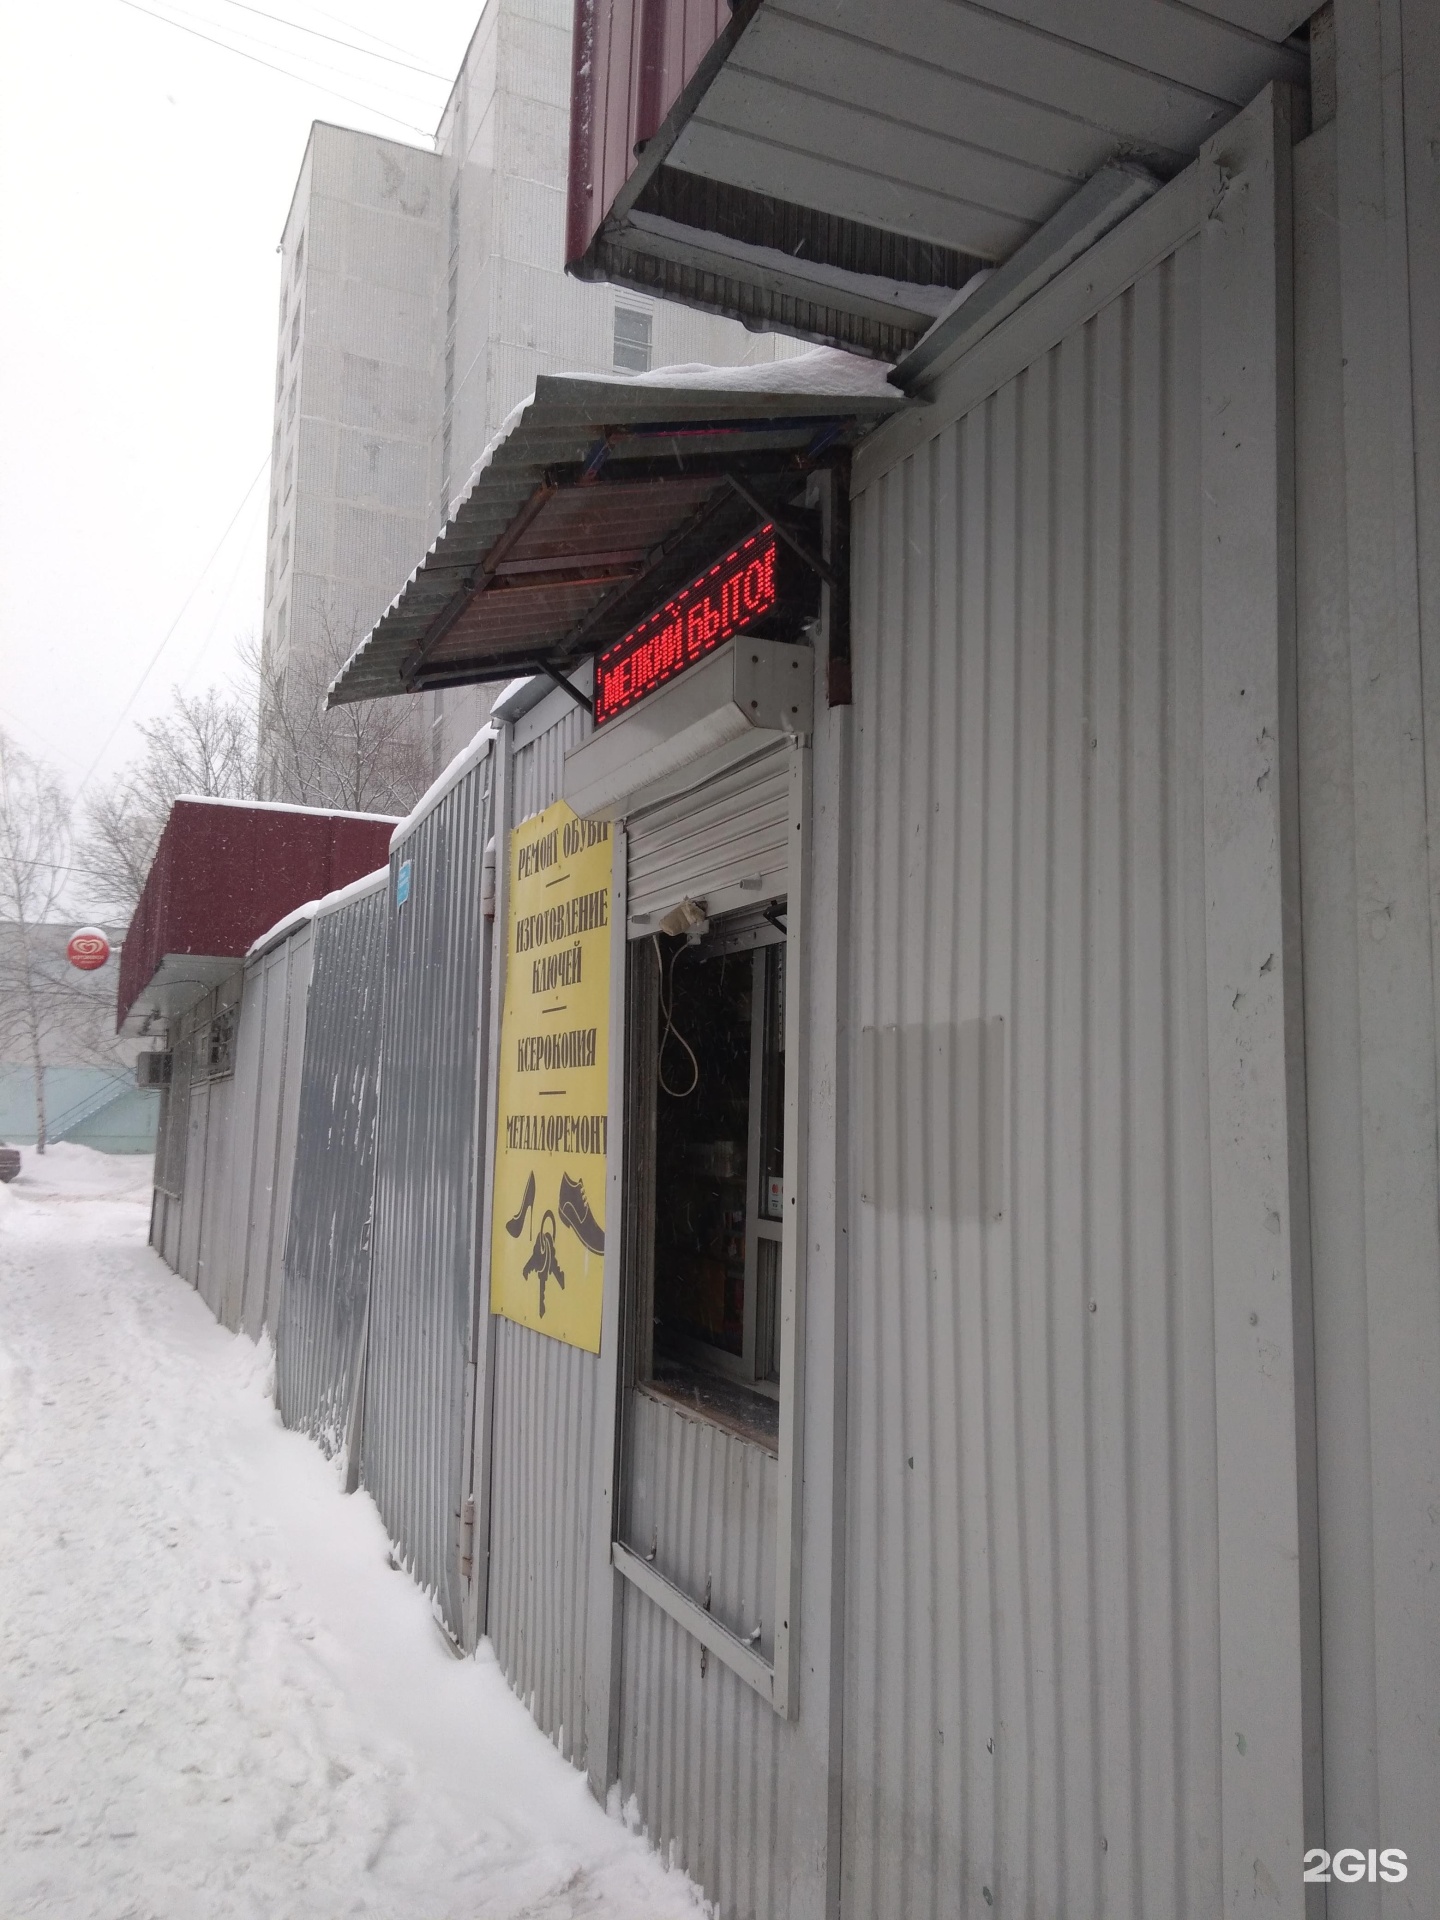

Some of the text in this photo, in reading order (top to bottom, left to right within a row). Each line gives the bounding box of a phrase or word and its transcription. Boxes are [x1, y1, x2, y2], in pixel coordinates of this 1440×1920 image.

[517, 818, 609, 881] РЕМОНТ ОБУВИ
[515, 887, 609, 954] ИЗГОТОВЛЕНИЕ
[531, 939, 584, 995] КЛЮЧЕЙ
[516, 1028, 598, 1073] КСЕРОКОПИЯ
